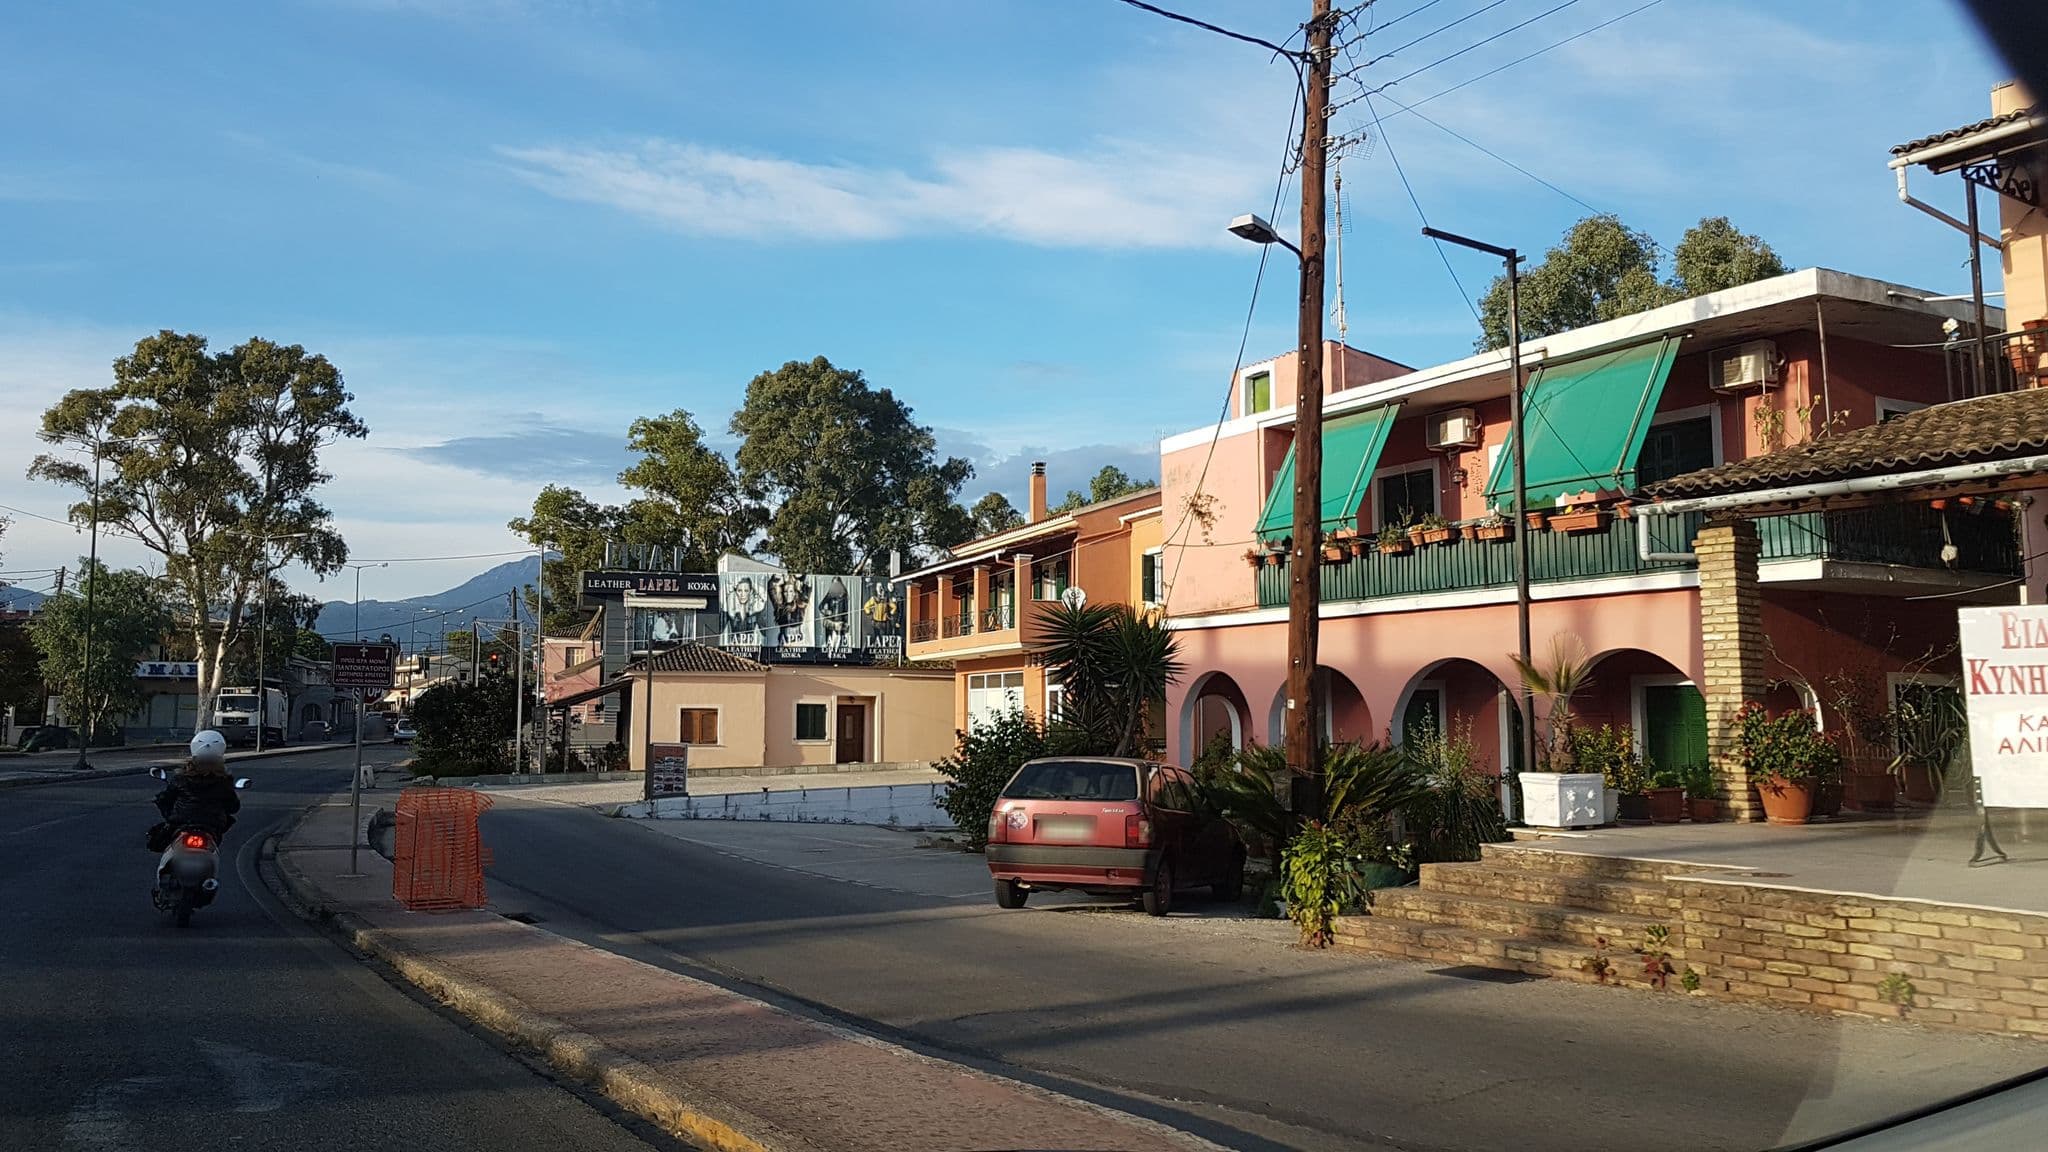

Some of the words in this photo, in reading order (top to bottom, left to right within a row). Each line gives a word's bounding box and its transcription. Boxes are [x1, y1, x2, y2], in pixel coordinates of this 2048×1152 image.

[588, 579, 632, 589] LEATHER
[638, 578, 680, 592] LAPEL
[687, 582, 717, 592] КОЖА
[1998, 736, 2048, 755] ΑΛΙ
